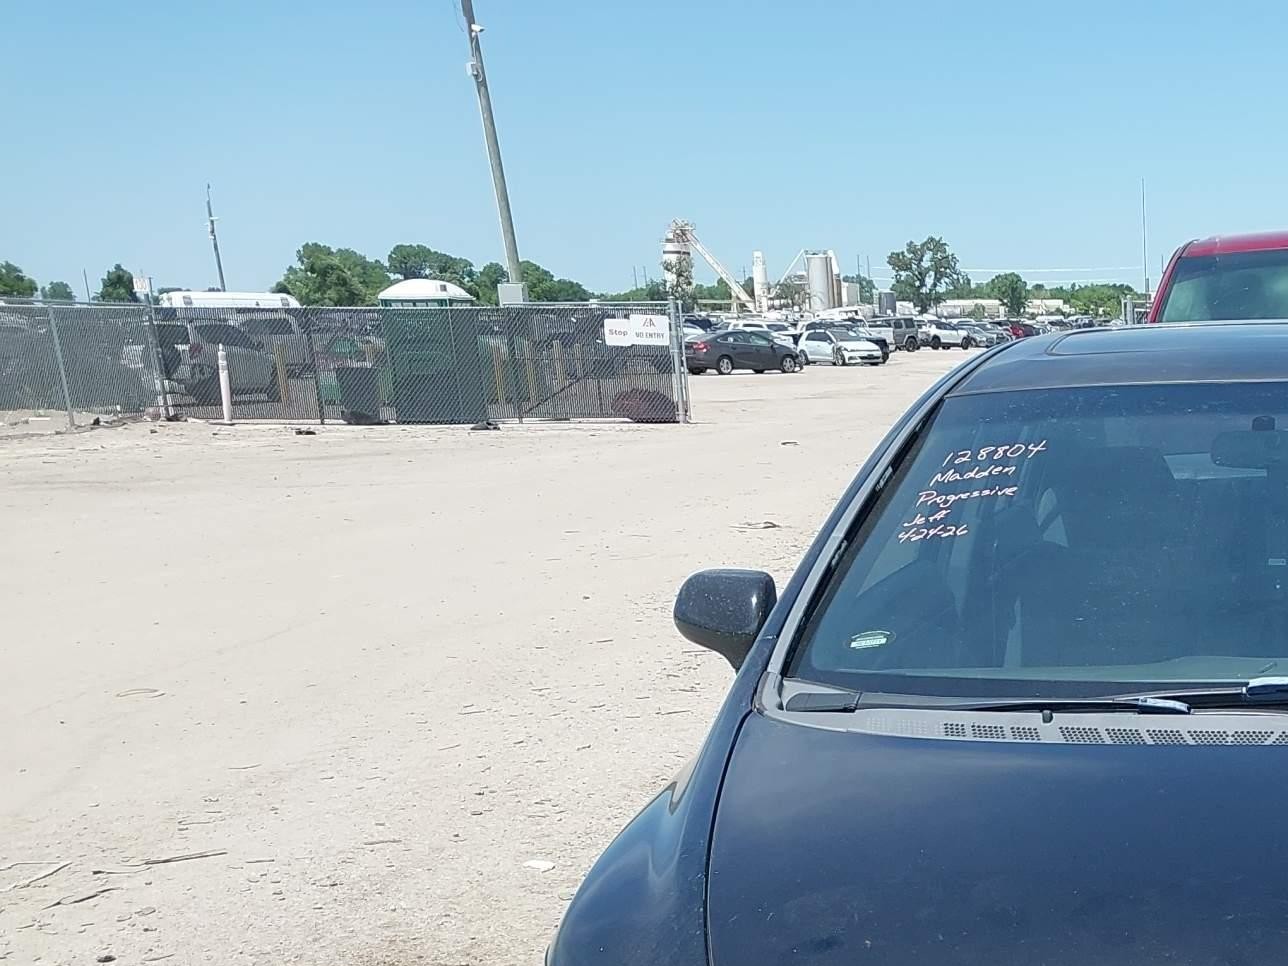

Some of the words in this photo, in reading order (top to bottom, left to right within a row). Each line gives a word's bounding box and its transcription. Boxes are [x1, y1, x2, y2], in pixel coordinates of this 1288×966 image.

[942, 440, 1047, 467] 128804
[929, 465, 1016, 487] Madden
[915, 485, 1018, 508] Progressive
[903, 510, 951, 527] Jeff
[897, 525, 968, 543] 4-24-26
